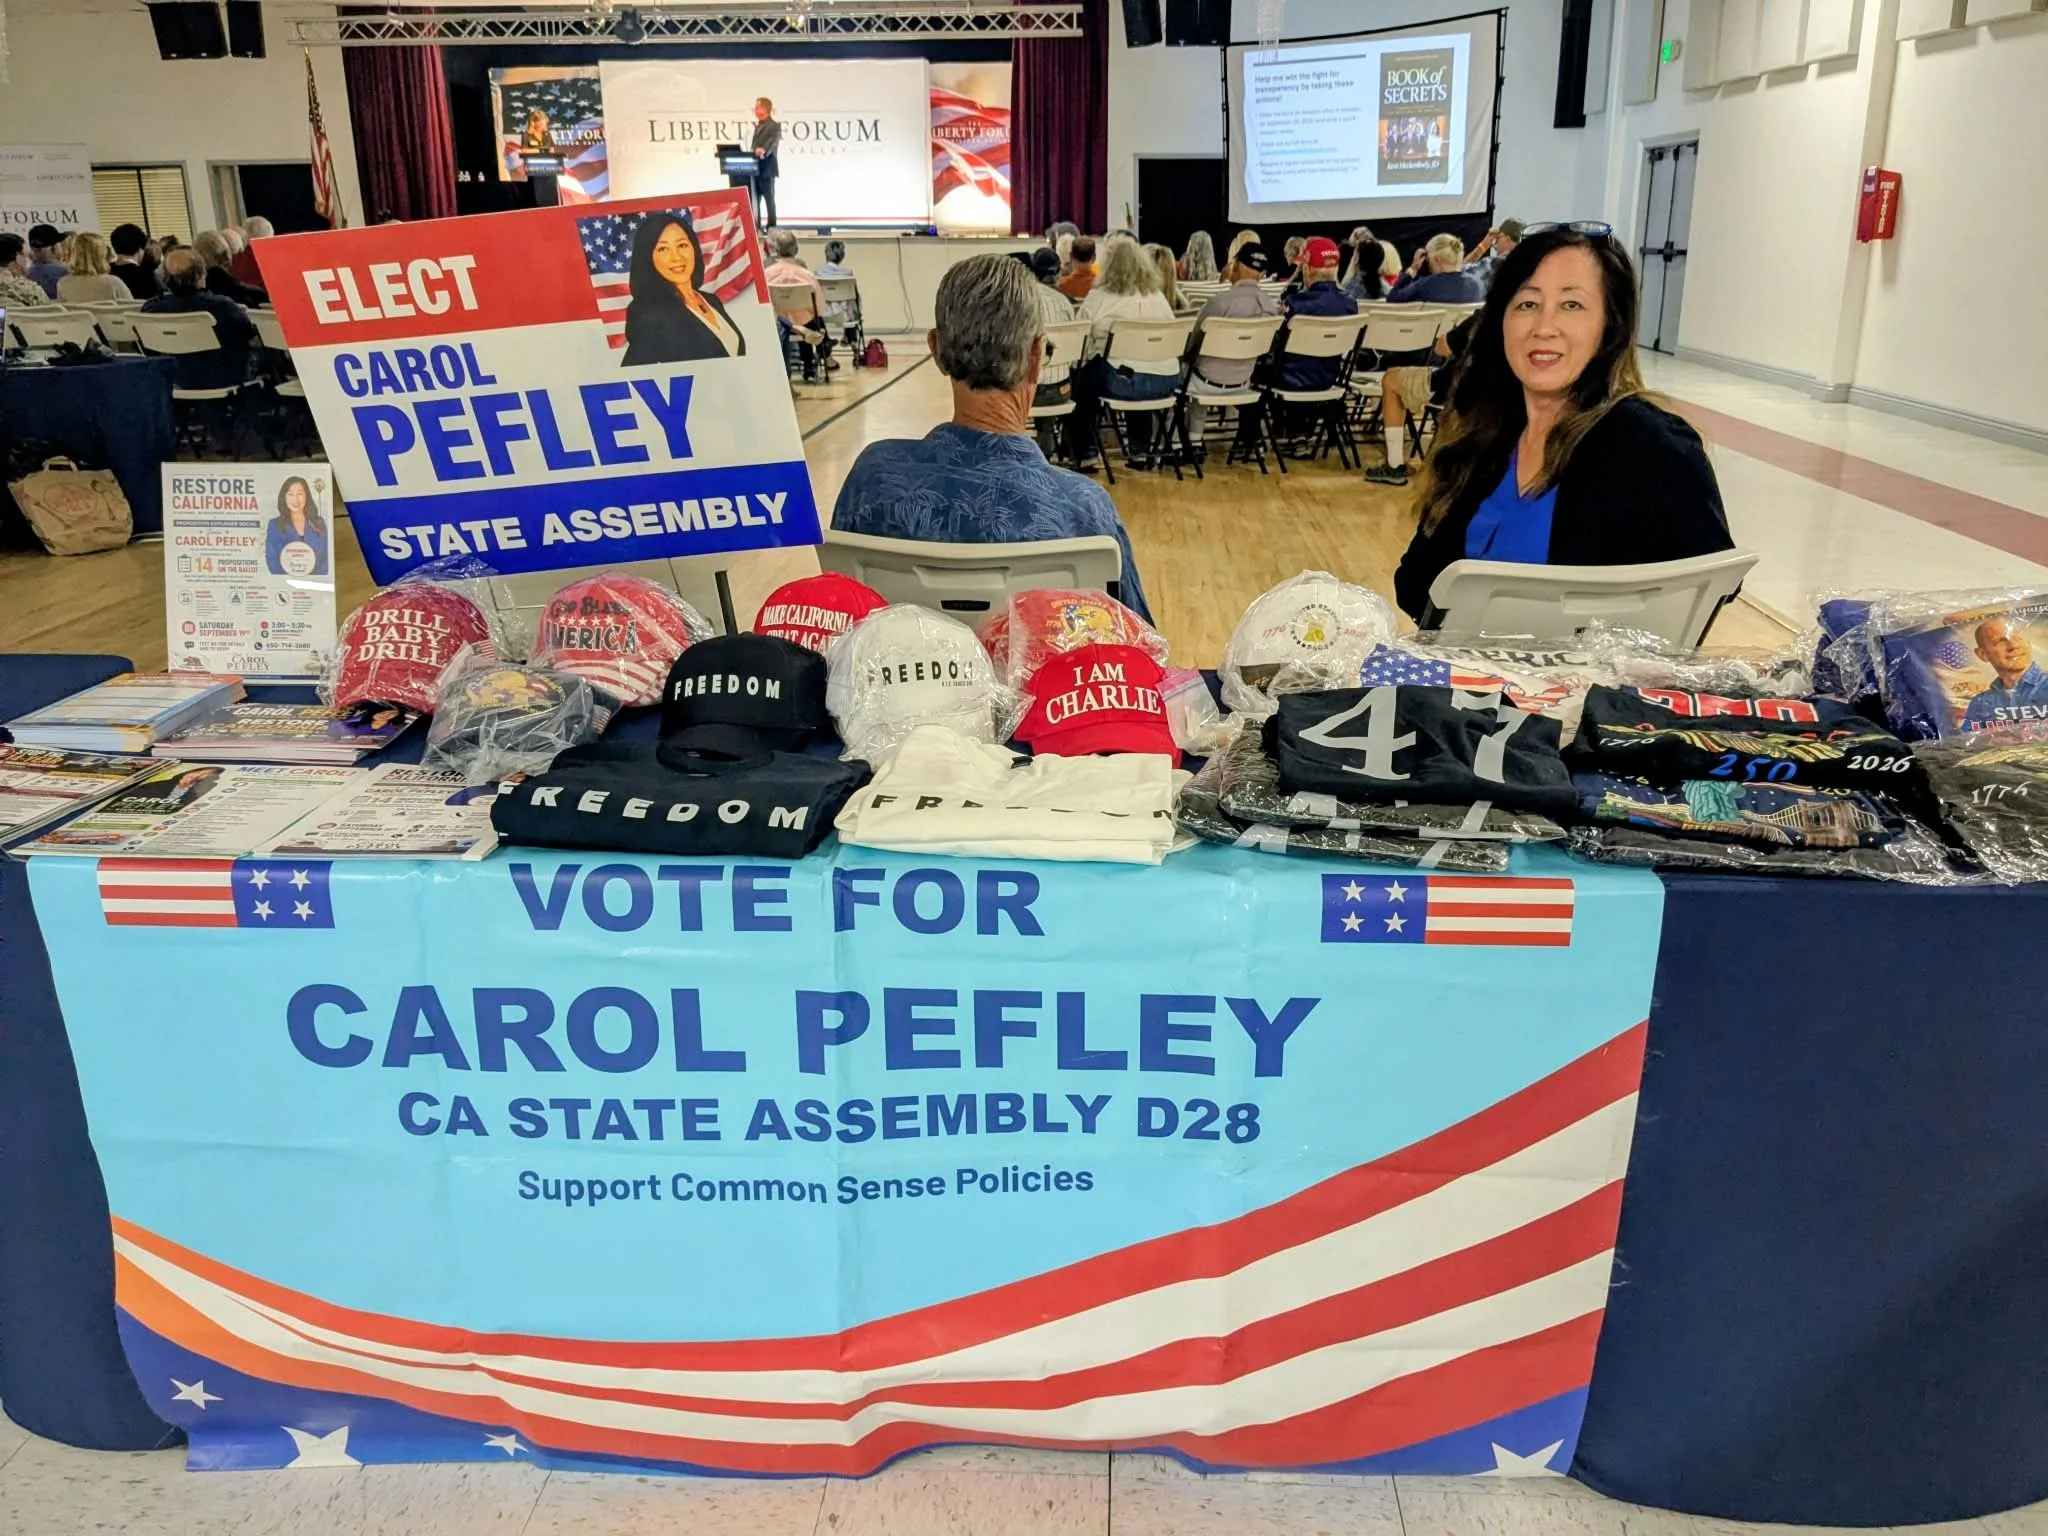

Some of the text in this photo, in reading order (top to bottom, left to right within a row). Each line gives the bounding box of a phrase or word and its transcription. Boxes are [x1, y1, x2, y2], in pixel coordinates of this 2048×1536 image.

[1387, 65, 1448, 87] BOOK of
[1384, 85, 1447, 104] SECRETS
[779, 119, 881, 142] FORUM
[3, 209, 79, 225] FORUM
[303, 256, 478, 324] ELECT
[335, 343, 496, 398] CAROL
[352, 376, 694, 487] PEFLEY
[172, 478, 256, 495] RESTORE
[172, 495, 259, 511] CALIFORNIA
[380, 493, 787, 560] STATE ASSEMBLY
[175, 535, 257, 547] CAROL PEFLEY
[194, 556, 214, 573] 14
[362, 609, 450, 633] DRILL
[761, 604, 855, 633] MAKE CALIFORNIA
[364, 625, 447, 649] BABY
[800, 631, 842, 656] AGAI
[232, 656, 265, 664] CAROL
[358, 643, 447, 668] DRILL
[674, 674, 781, 700] FREEDOM
[1073, 663, 1127, 687] I AM
[233, 707, 297, 717] CAROL
[1046, 684, 1162, 724] CHARLIE
[237, 718, 329, 726] RESTORE
[1298, 687, 1529, 784] 47
[237, 766, 289, 774] MEET
[1708, 754, 1798, 783] 250
[1847, 755, 1916, 773] 2026
[121, 796, 182, 805] CAROL
[498, 781, 809, 832] FREEDOM
[509, 863, 1046, 936] VOTE FOR
[286, 984, 1322, 1078] CAROL PEFLEY
[399, 1092, 1262, 1145] CA STATE ASSEMBLY D28
[519, 1164, 1095, 1207] Support Common Sense Policies
